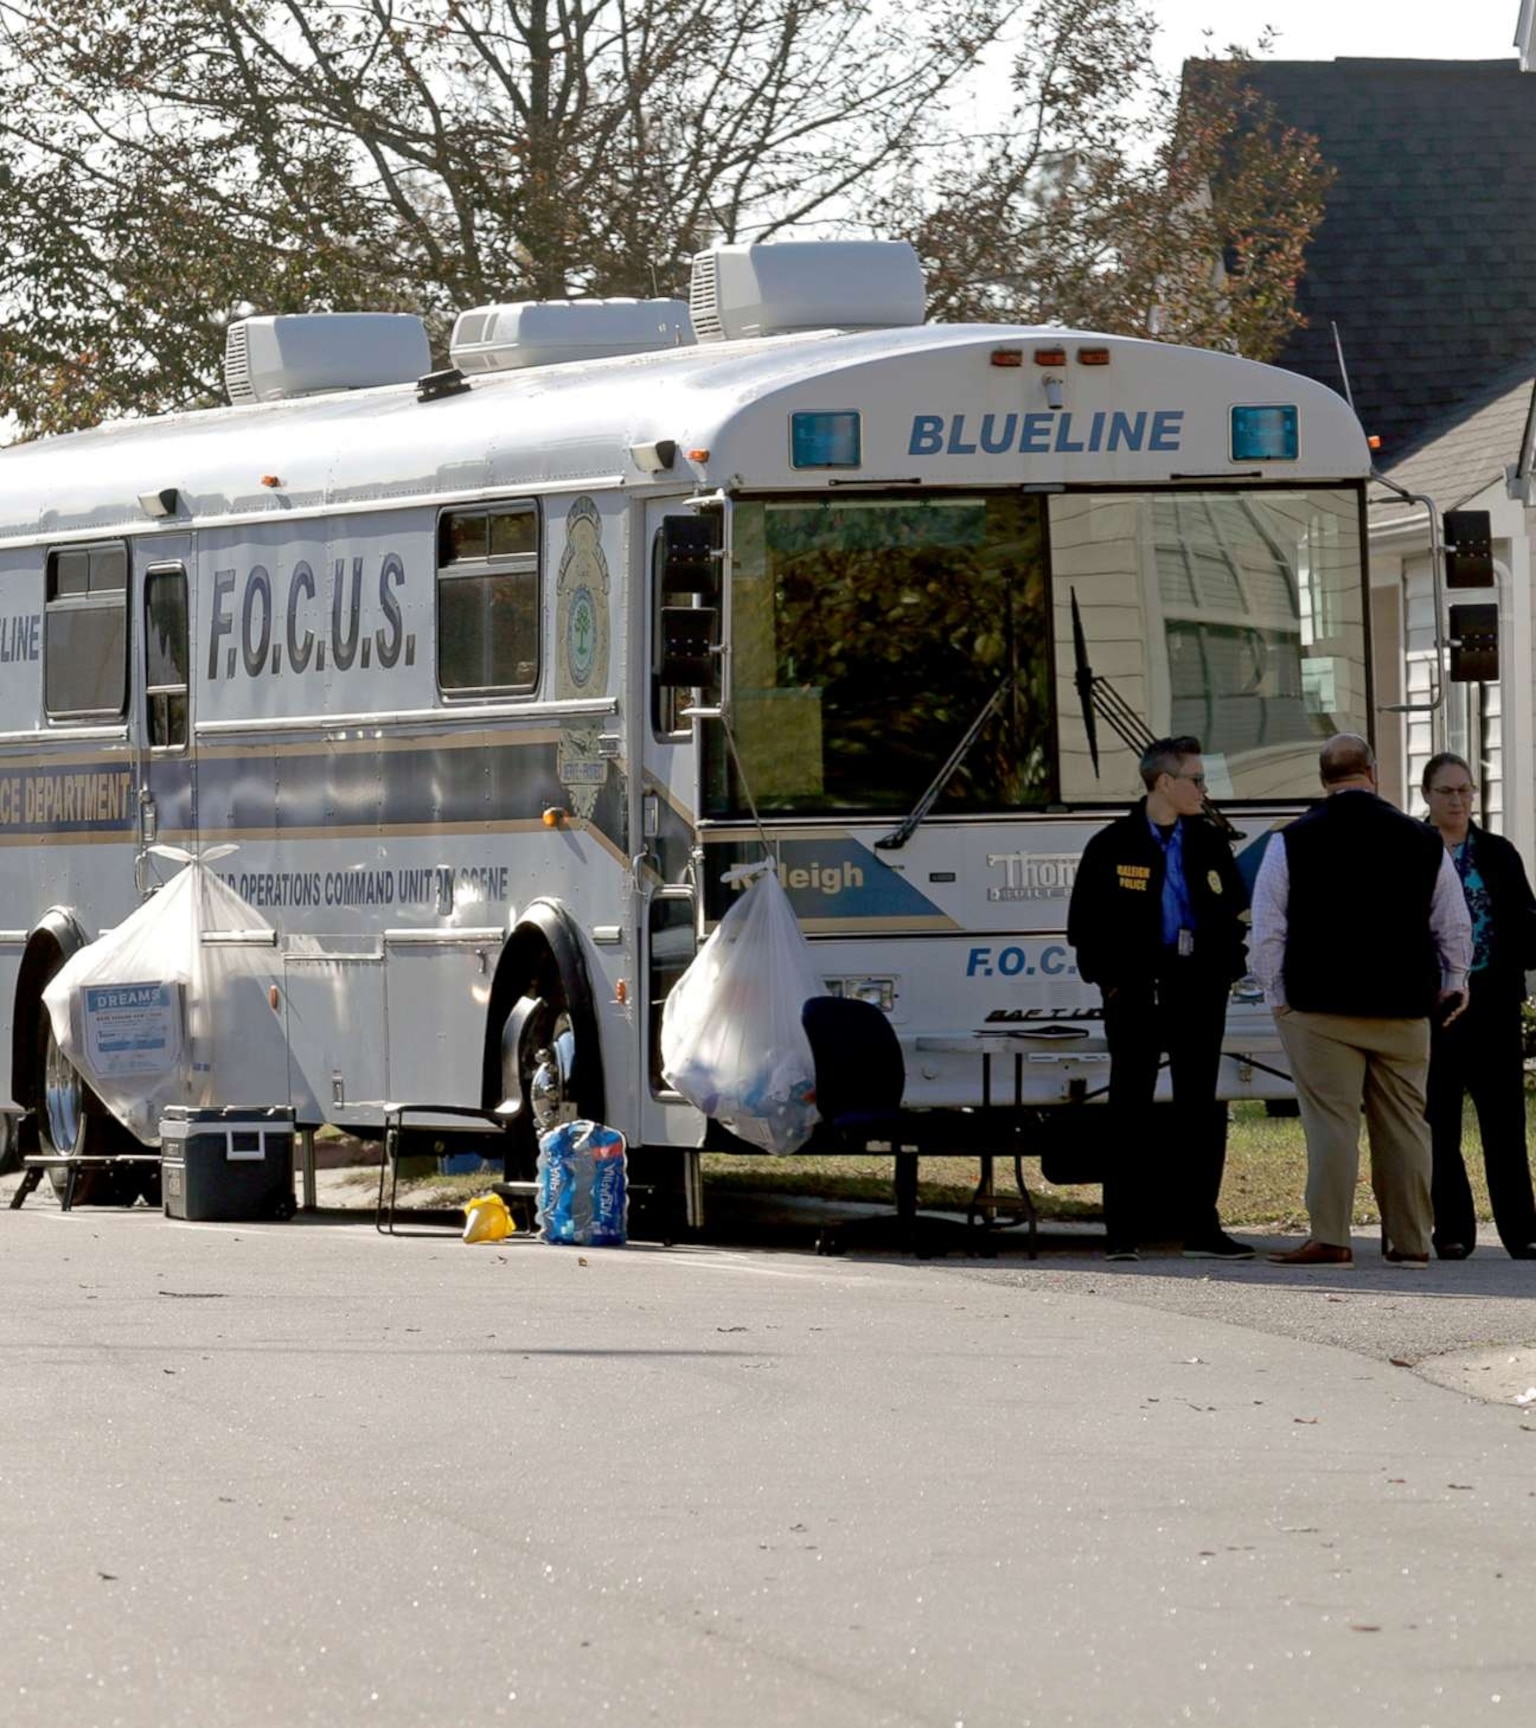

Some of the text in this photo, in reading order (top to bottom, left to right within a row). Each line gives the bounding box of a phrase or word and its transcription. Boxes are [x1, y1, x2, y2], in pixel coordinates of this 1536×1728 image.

[908, 411, 1184, 455] BLUELINE
[208, 552, 416, 680] F.O.C.U.S.
[24, 771, 131, 823] DEPARTMENT
[239, 871, 322, 907] OPERATIONS
[324, 870, 394, 906] COMMAND
[398, 868, 433, 904] UNIT
[729, 861, 863, 894] Rleigh
[96, 988, 161, 1008] DREAMS
